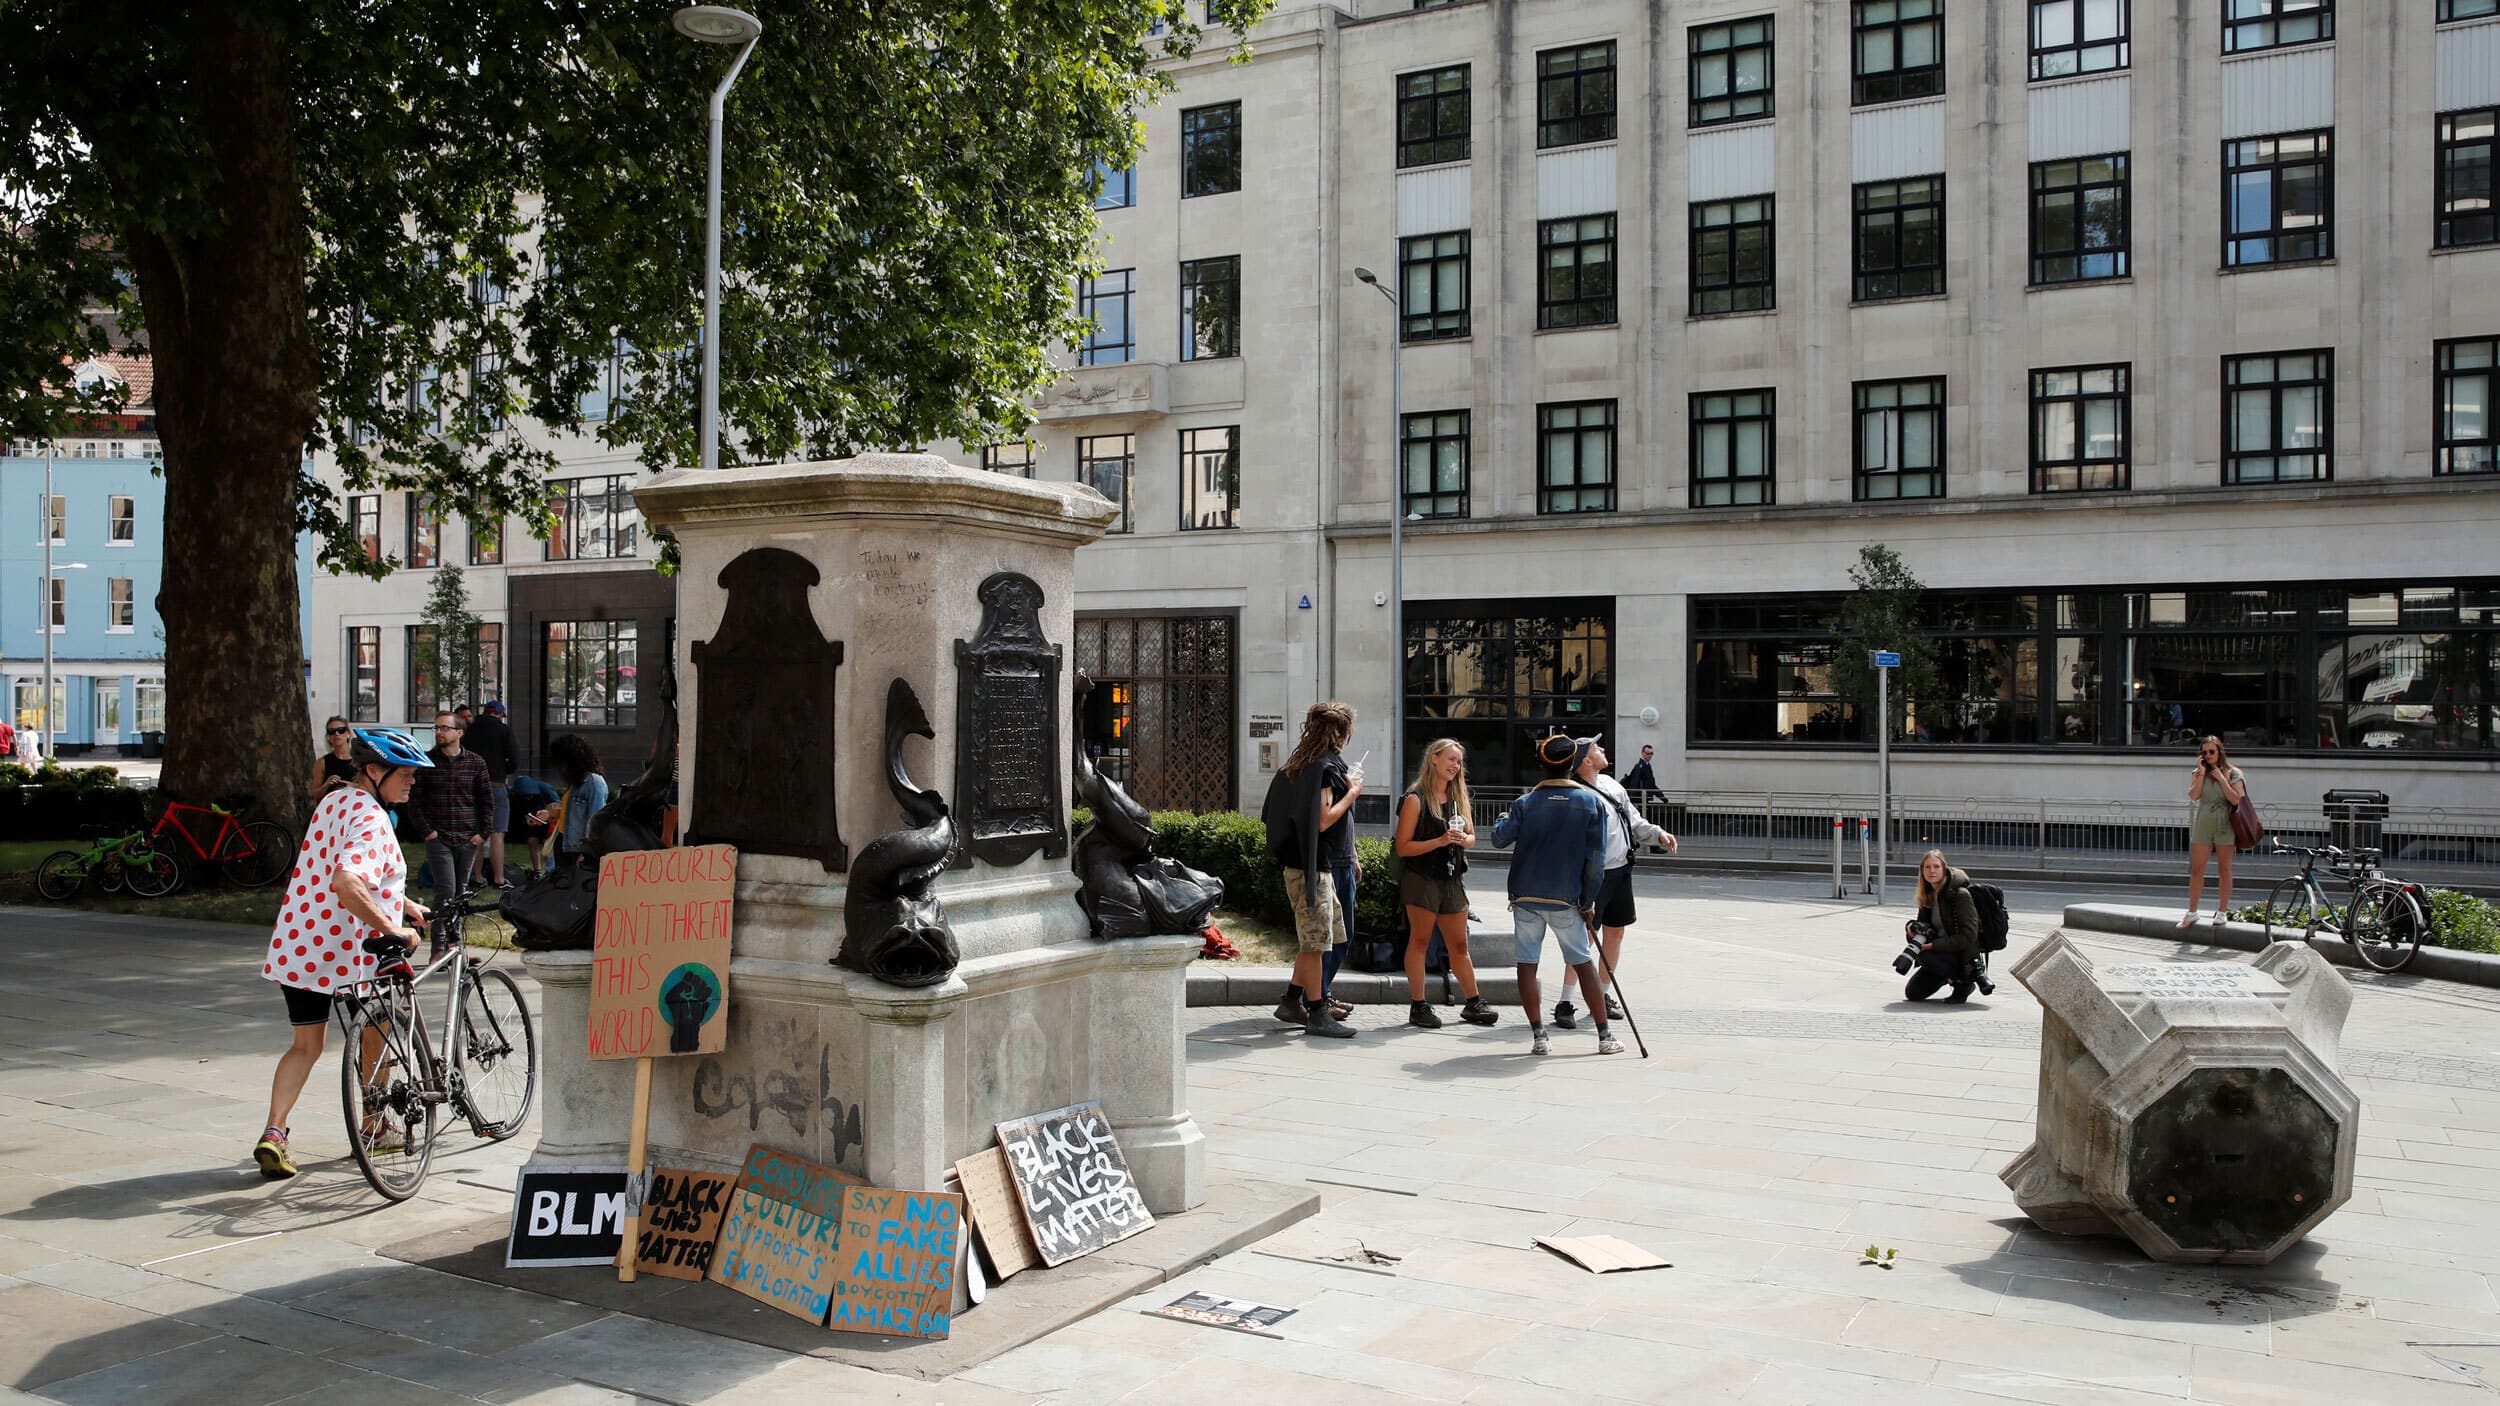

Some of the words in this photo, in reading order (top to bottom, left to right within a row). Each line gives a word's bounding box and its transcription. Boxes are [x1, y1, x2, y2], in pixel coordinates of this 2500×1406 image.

[595, 901, 656, 949] DON'T
[660, 899, 732, 945] THREAT
[593, 952, 651, 998] THIS
[588, 1006, 653, 1056] WORLD
[1008, 1114, 1113, 1182] BLACK
[528, 1190, 626, 1236] BLM
[648, 1175, 726, 1213] BLACK
[851, 1191, 893, 1214] SAY
[905, 1196, 955, 1227] NO
[848, 1221, 871, 1239] TO
[877, 1219, 957, 1257] FAKE
[1039, 1188, 1152, 1252] MATTER
[727, 1215, 823, 1280] SUPPORTS
[852, 1249, 951, 1290] ALLIES
[837, 1280, 926, 1307] BOYCOTT
[833, 1301, 950, 1335] AMAZON
